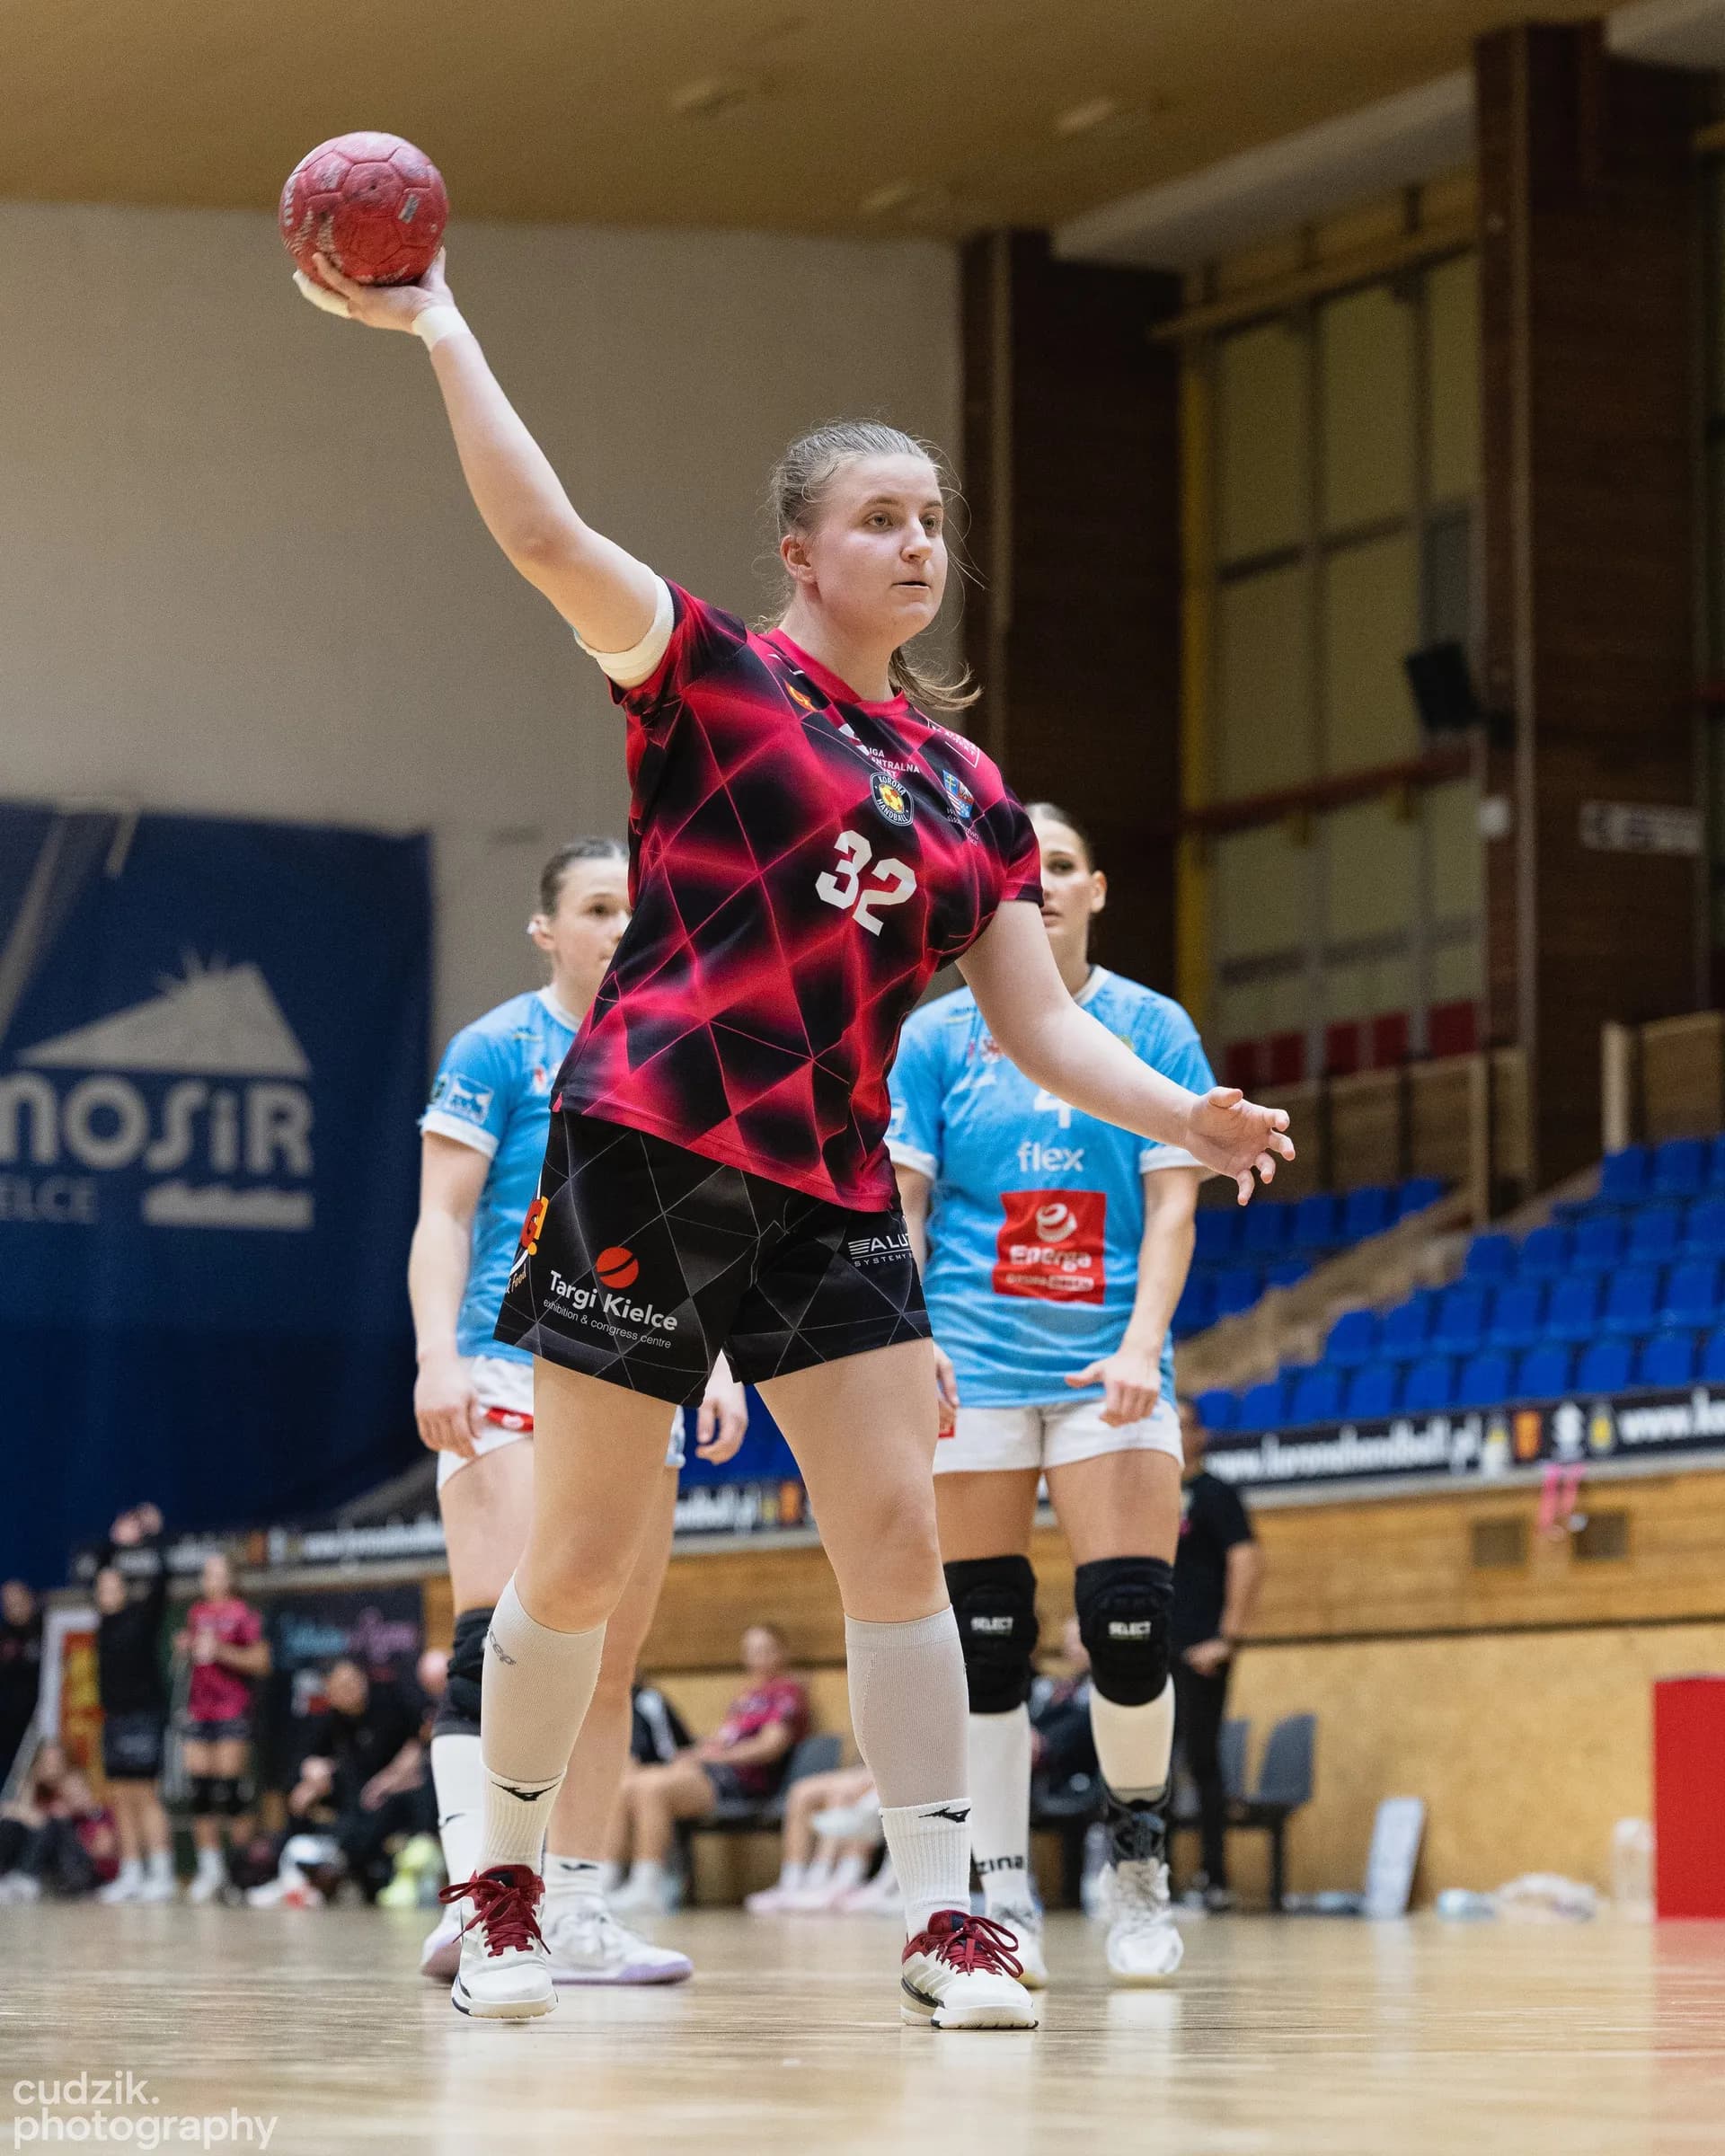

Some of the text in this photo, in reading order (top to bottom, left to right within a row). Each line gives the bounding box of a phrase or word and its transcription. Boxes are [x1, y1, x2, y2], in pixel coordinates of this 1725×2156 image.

[878, 775, 907, 797] KORONA
[876, 798, 908, 823] HANDBALL
[815, 831, 916, 936] 32
[1017, 1141, 1085, 1173] flex
[550, 1269, 678, 1331] Targi Kielce
[543, 1298, 672, 1349] exhibition & congress centre
